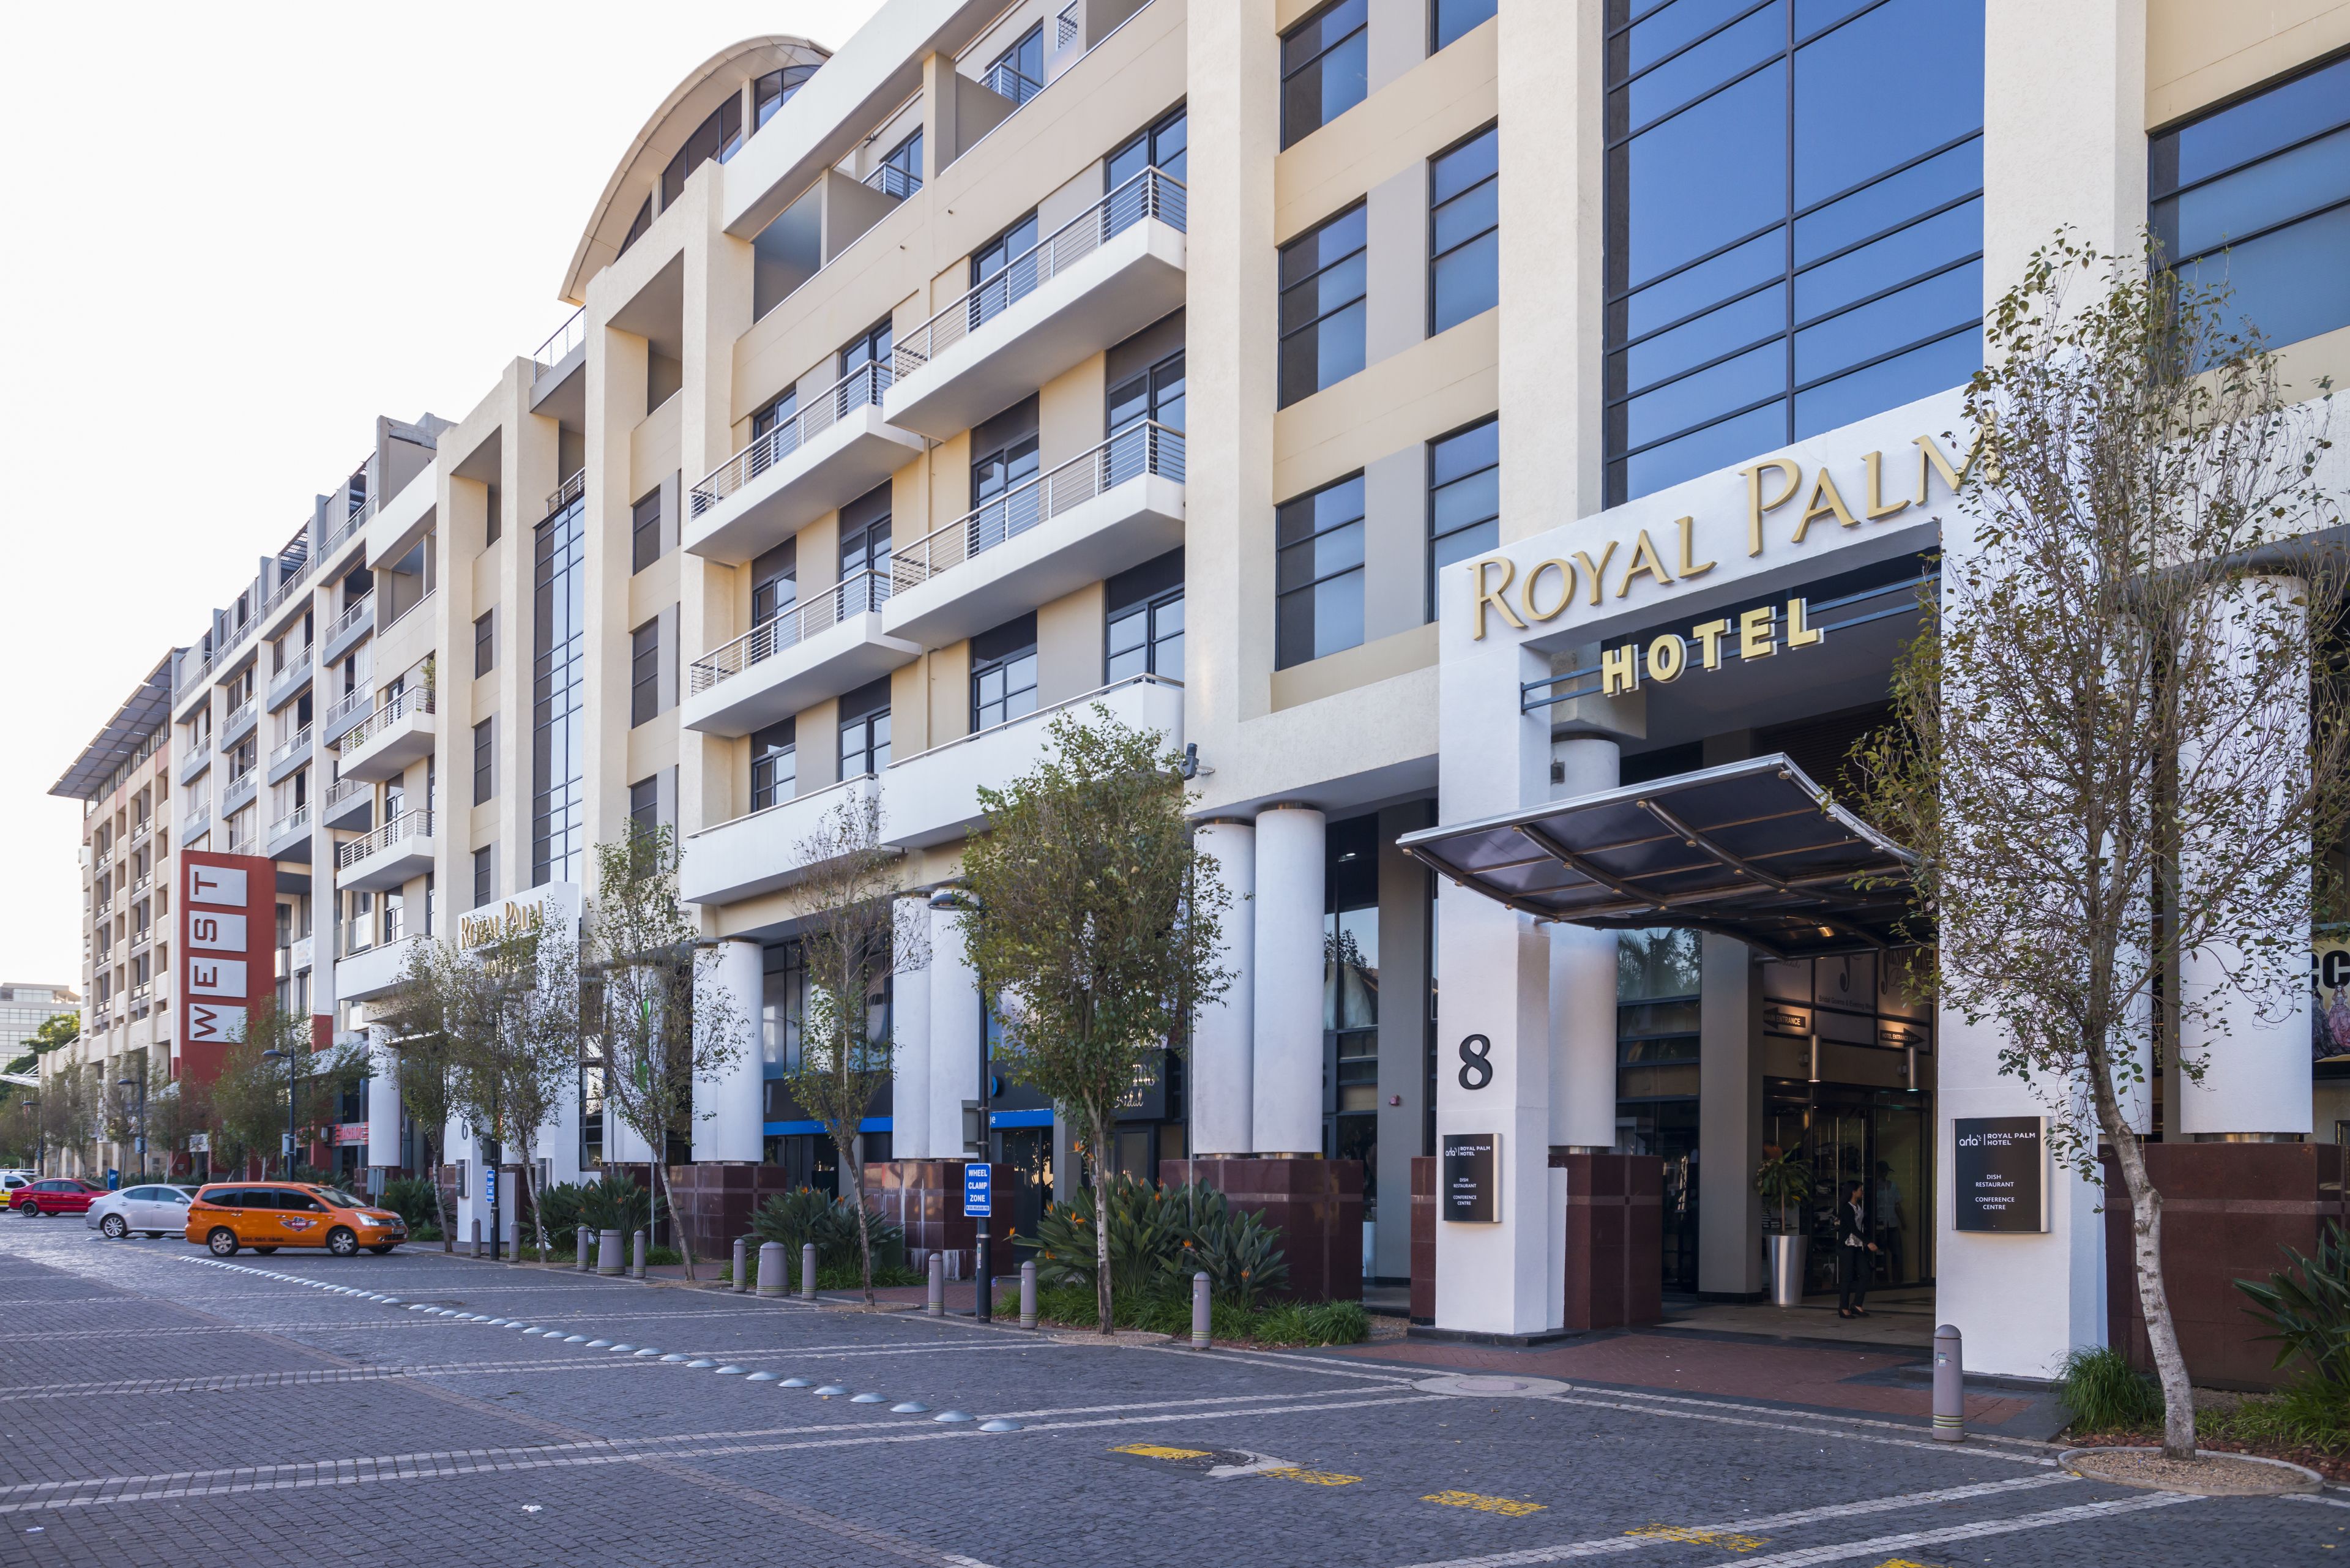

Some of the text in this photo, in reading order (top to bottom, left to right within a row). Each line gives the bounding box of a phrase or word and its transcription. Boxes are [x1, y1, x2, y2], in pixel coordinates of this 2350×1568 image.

[1467, 410, 2000, 641] ROYAL PALM
[1602, 597, 1823, 697] HOTEL
[194, 871, 218, 1039] WEST
[1777, 1015, 1800, 1025] ENTRANCE
[1458, 1034, 1493, 1090] 8
[461, 1116, 468, 1140] 6
